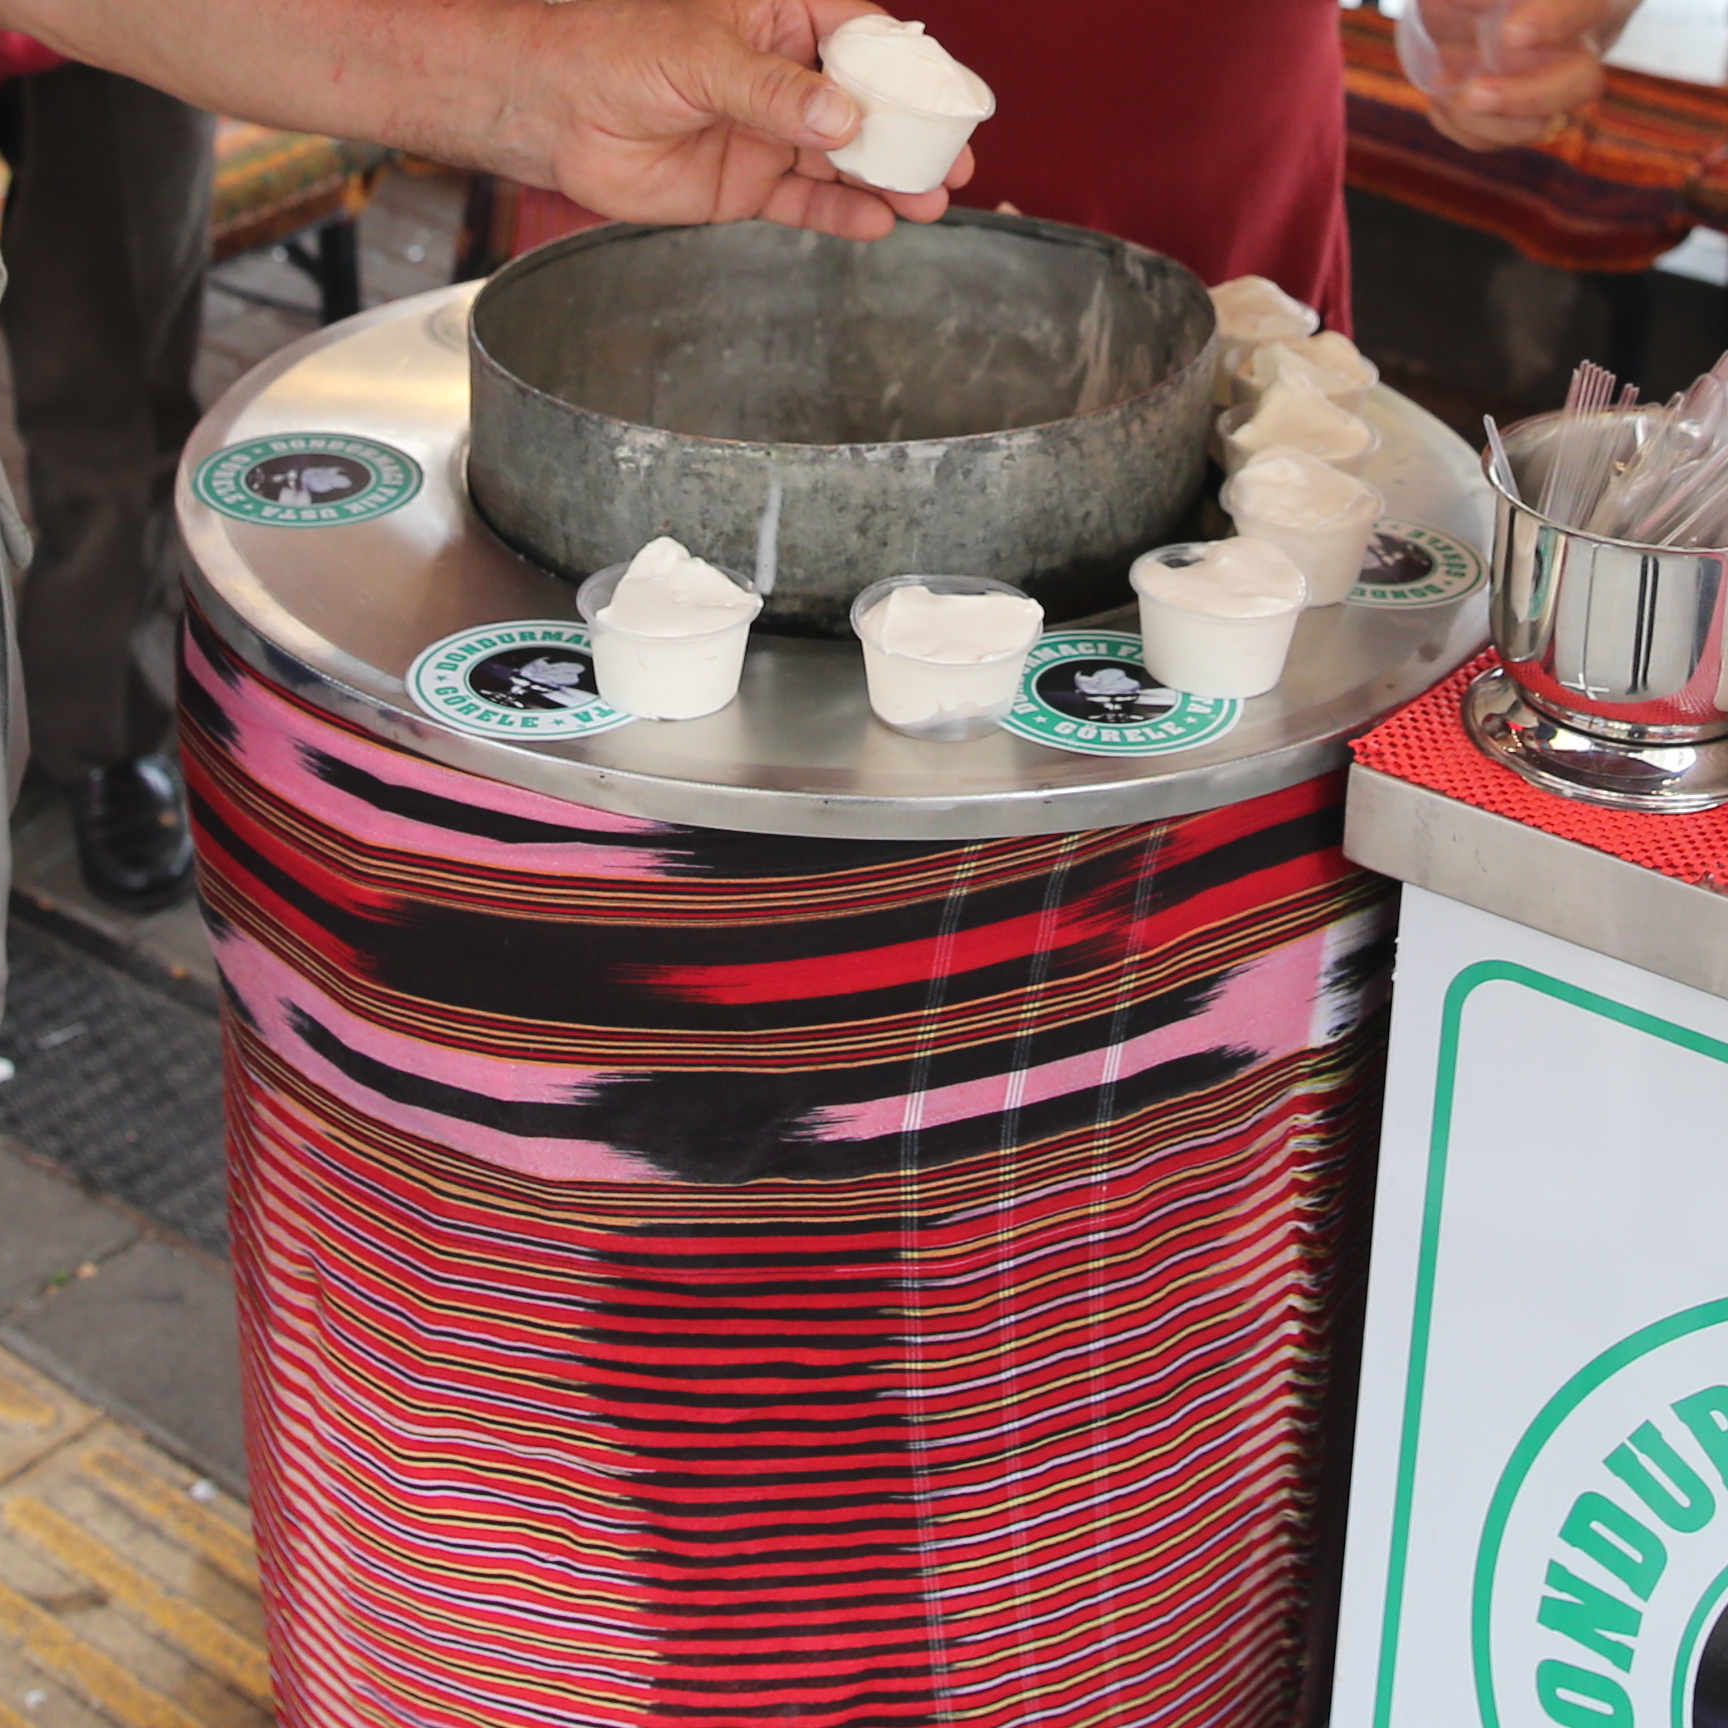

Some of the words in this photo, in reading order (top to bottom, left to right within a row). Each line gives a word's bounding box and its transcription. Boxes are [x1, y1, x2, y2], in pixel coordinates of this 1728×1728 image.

[434, 631, 592, 672] DONDURMA
[434, 685, 539, 728] GÖRELE
[1053, 720, 1188, 742] GÖRELE
